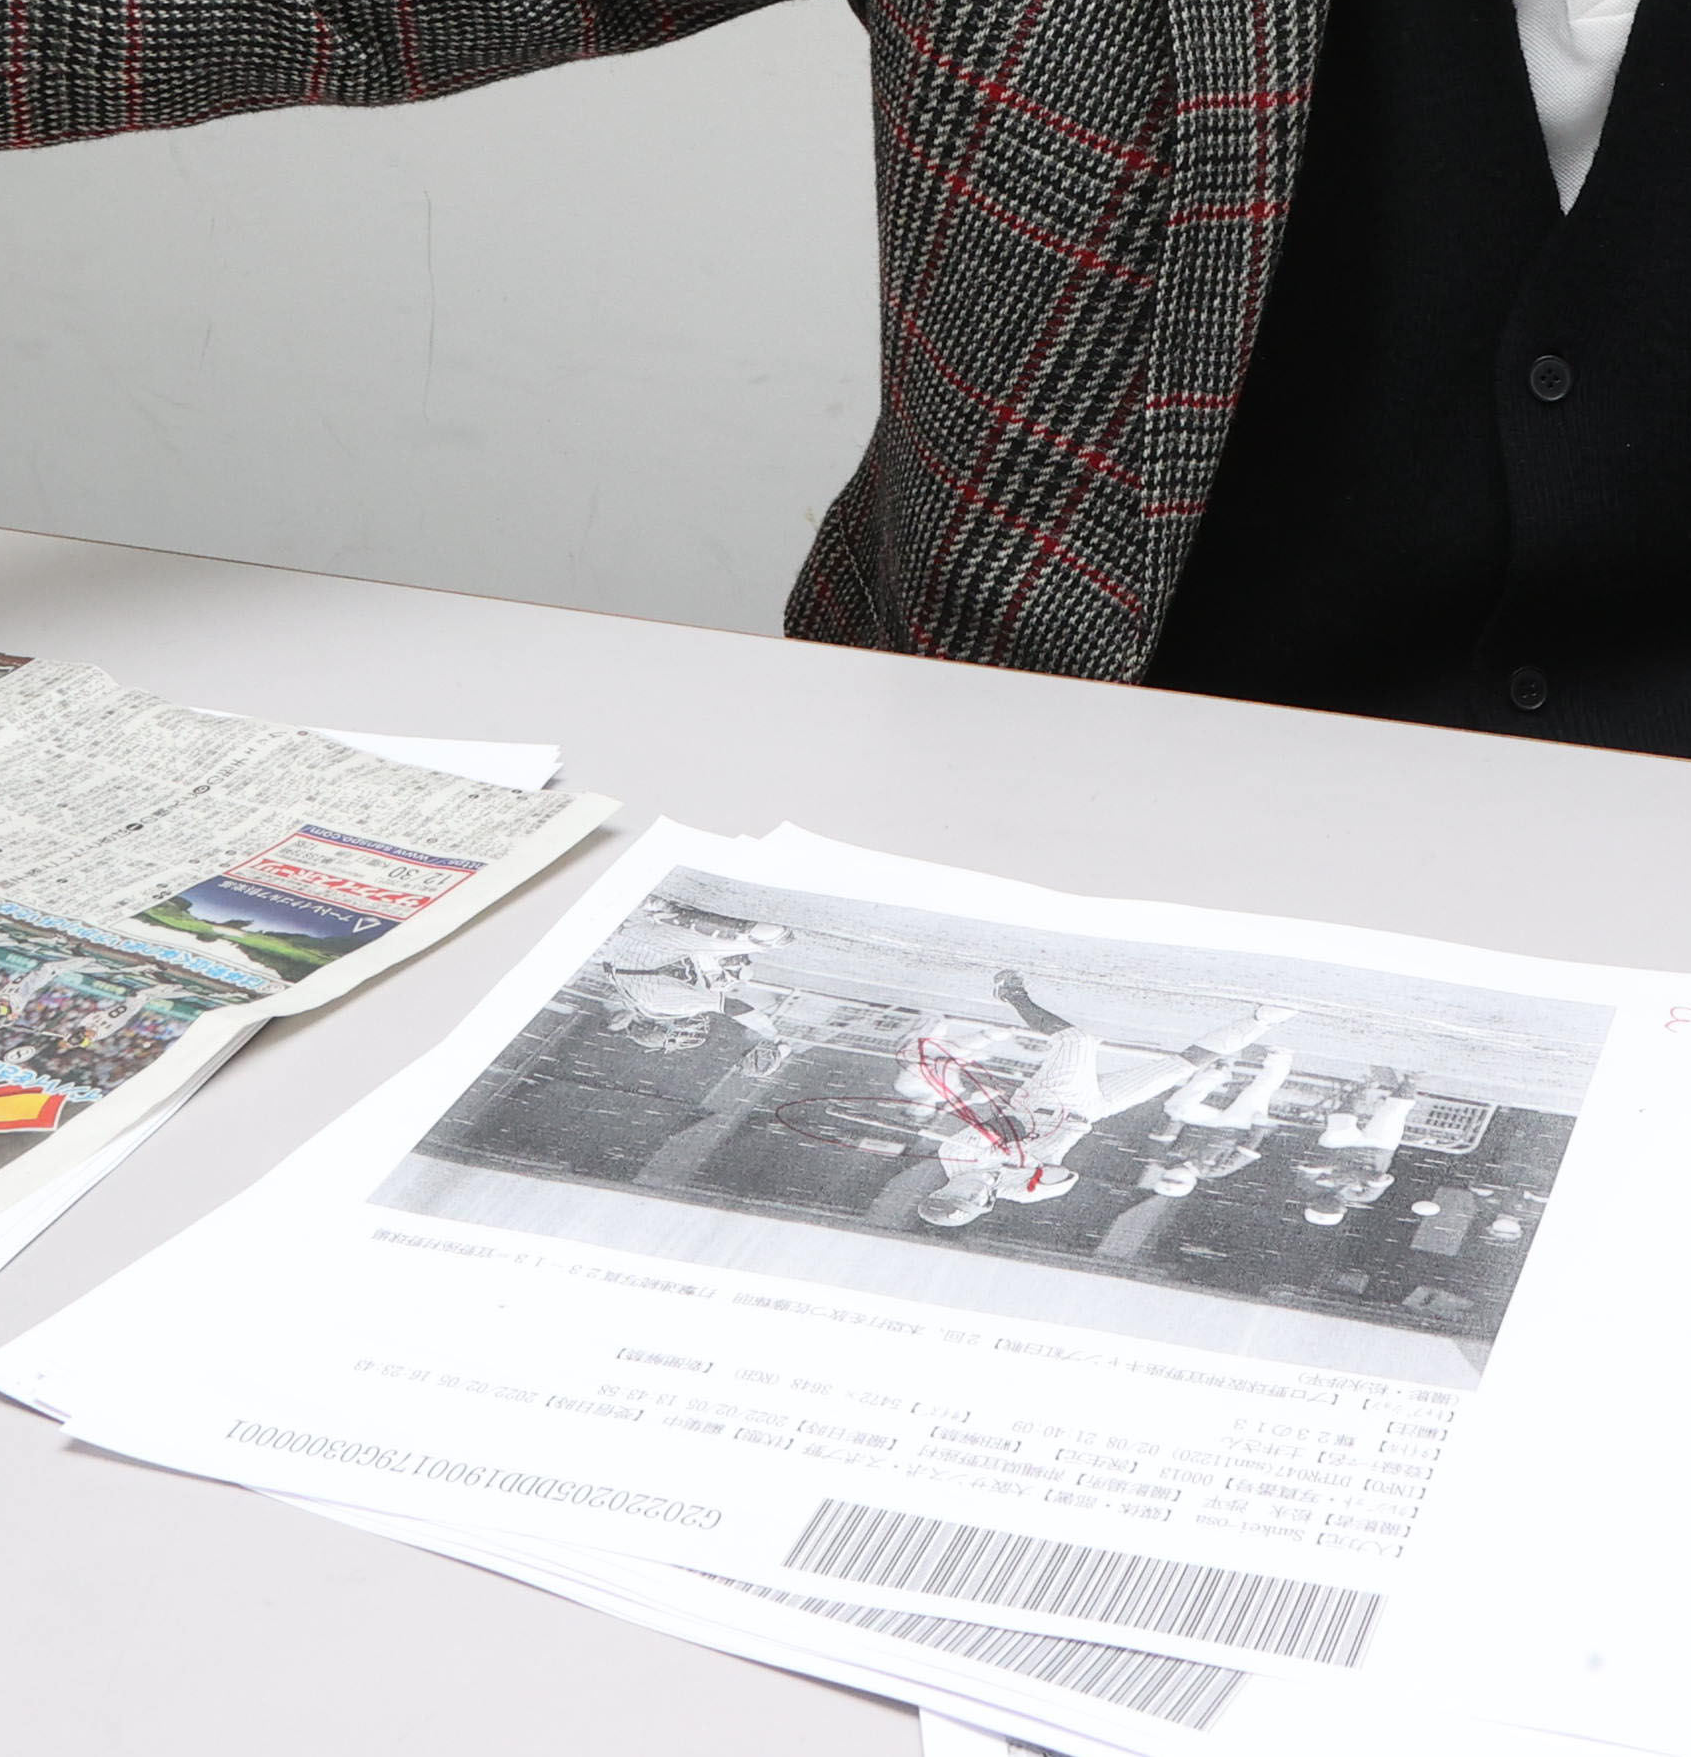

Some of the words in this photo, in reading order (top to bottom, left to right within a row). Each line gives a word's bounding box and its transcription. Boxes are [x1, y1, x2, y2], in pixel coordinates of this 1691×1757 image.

[248, 858, 429, 907] サンケイスポーツ
[384, 865, 455, 886] 12/30
